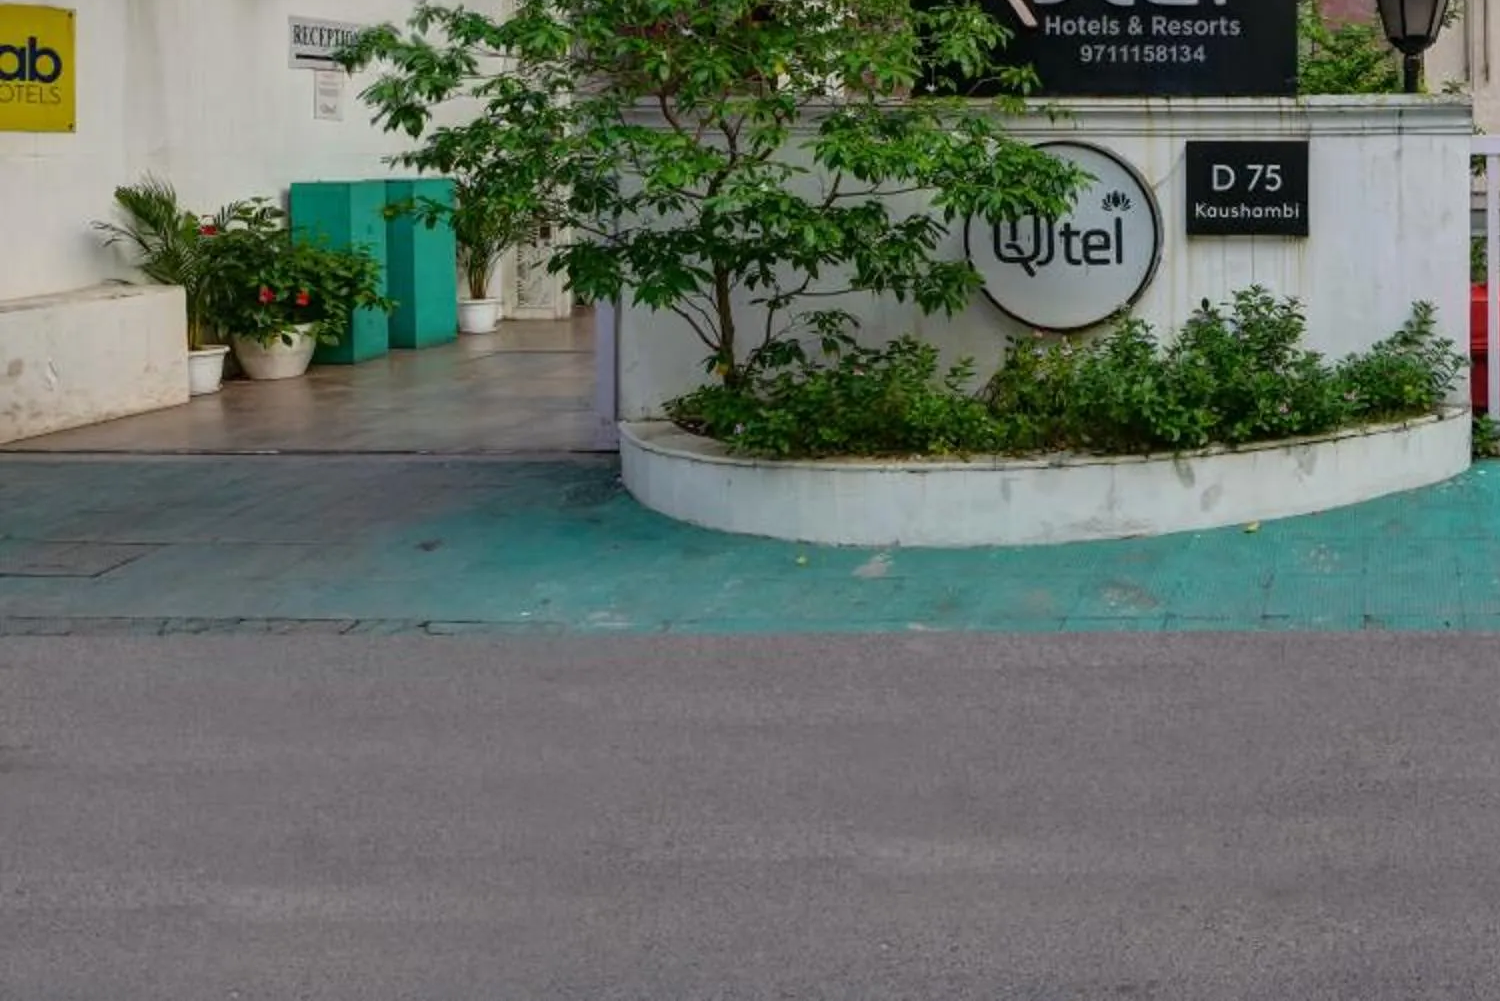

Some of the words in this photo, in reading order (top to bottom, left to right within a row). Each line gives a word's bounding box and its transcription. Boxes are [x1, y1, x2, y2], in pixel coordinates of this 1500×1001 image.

[293, 24, 361, 48] RECEPTIO
[1045, 15, 1120, 36] Hotels
[1127, 15, 1144, 36] &
[1152, 15, 1241, 36] Resorts
[1080, 45, 1206, 64] 9711158134
[1212, 164, 1236, 191] D
[1246, 164, 1283, 192] 75
[1194, 202, 1300, 219] Kaushambi
